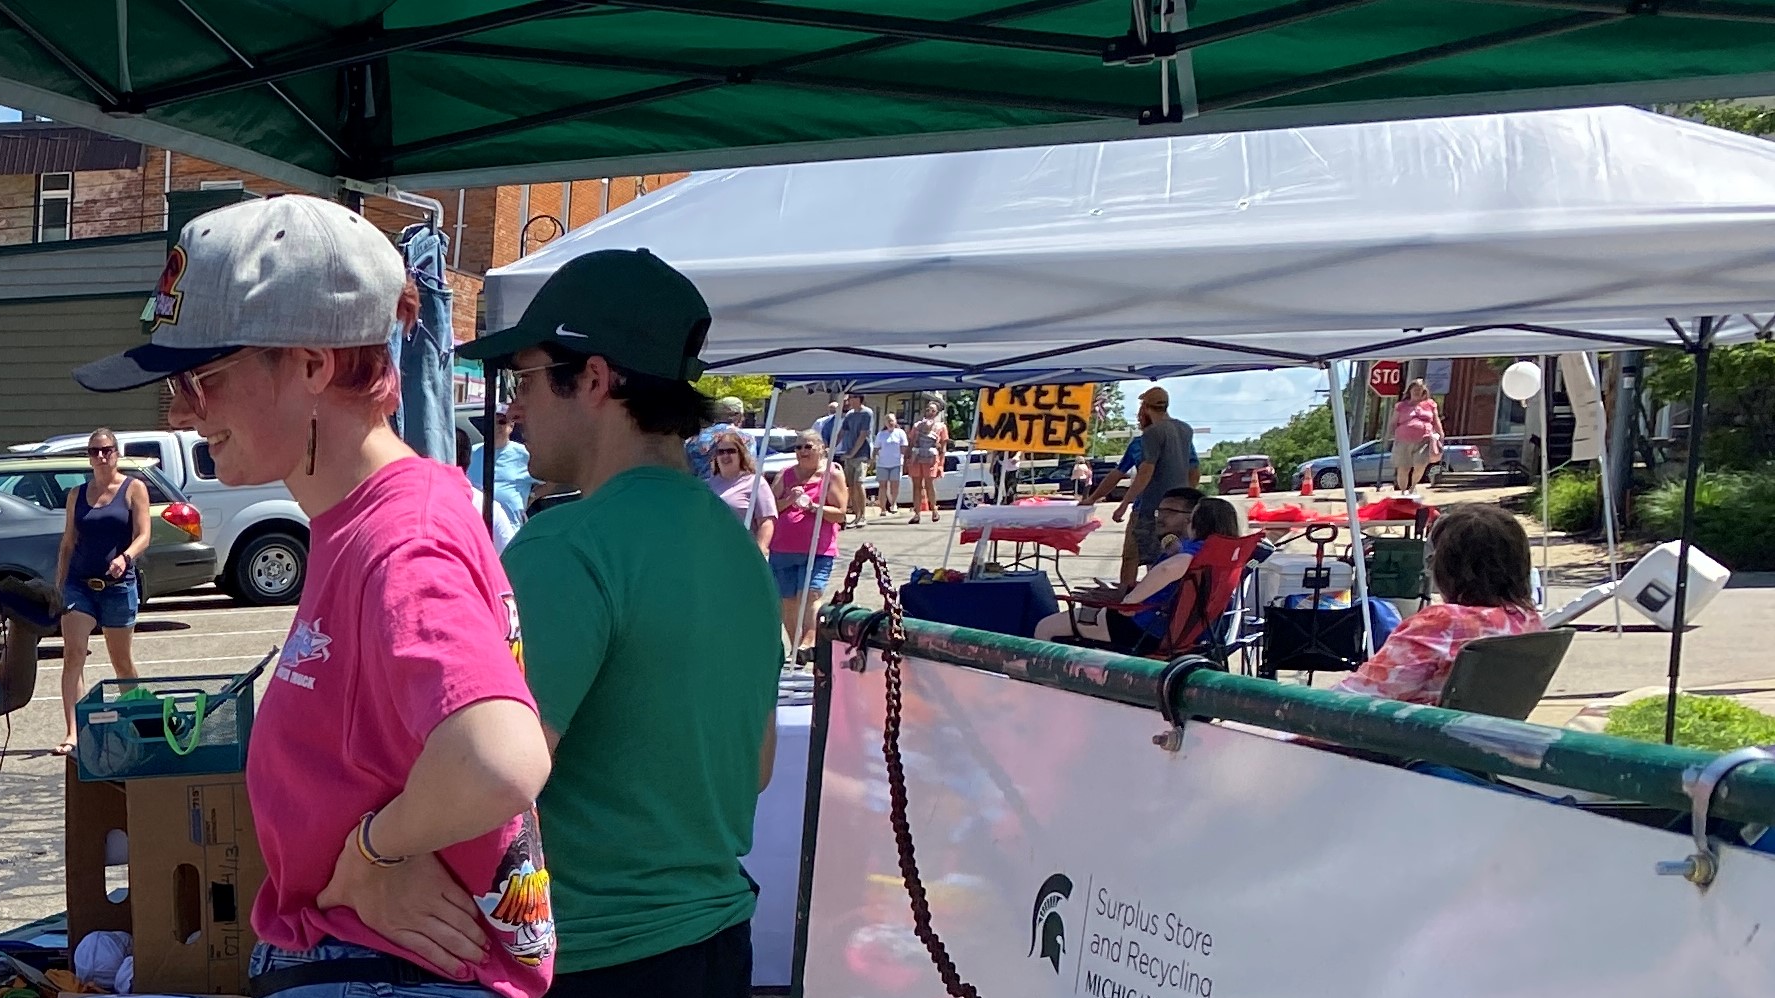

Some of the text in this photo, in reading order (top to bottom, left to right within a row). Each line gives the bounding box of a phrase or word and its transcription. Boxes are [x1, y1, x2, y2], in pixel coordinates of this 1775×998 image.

[1371, 368, 1400, 385] STO
[979, 411, 1087, 448] WATER
[1096, 887, 1213, 956] Surplus Store
[1090, 933, 1123, 963] and
